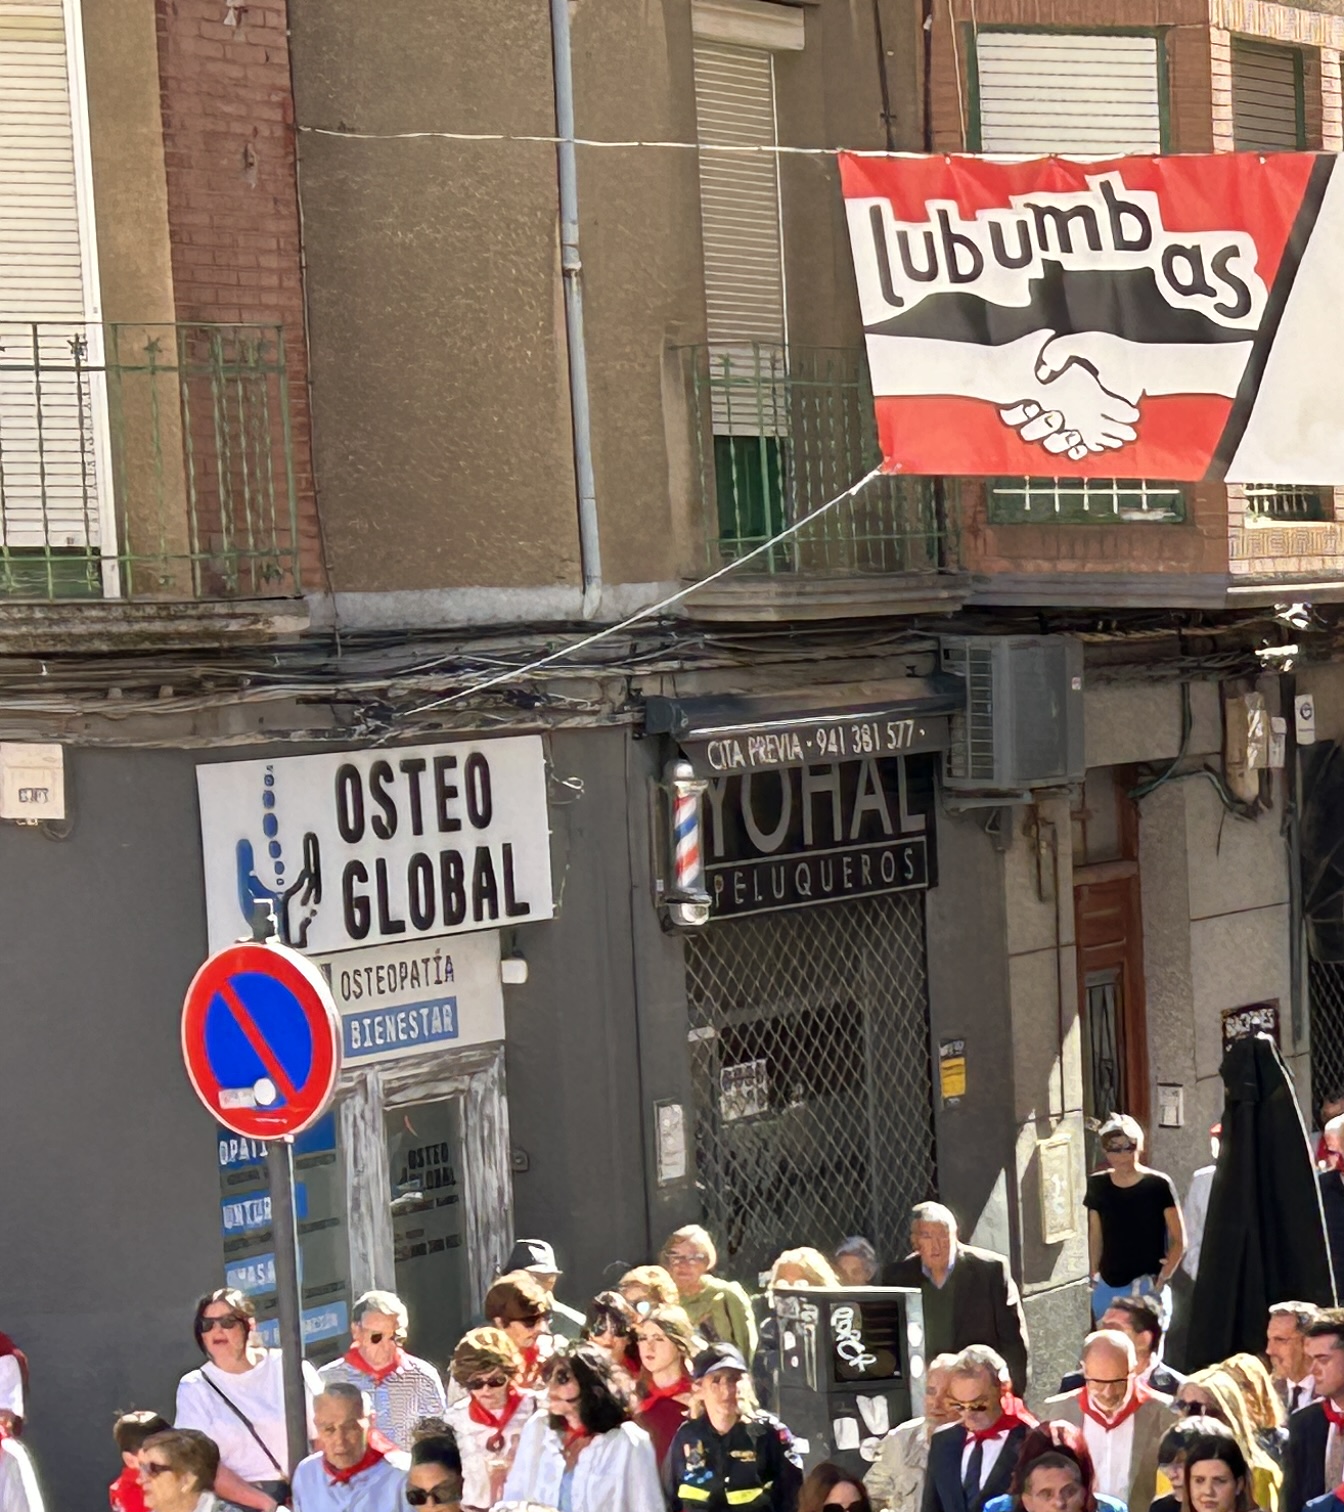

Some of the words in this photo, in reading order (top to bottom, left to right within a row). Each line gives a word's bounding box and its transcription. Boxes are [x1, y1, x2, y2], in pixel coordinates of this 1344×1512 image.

[707, 740, 746, 770] CITA
[748, 732, 804, 766] PREVIA
[816, 726, 846, 756] 941
[851, 722, 881, 753] 381
[887, 719, 915, 749] 577
[335, 752, 492, 843] OSTEO
[342, 843, 530, 940] GLOBAL
[713, 847, 914, 908] PELUQUEROS
[341, 948, 456, 1001] OSTEOPATÍA
[350, 1004, 454, 1050] BIENESTAR
